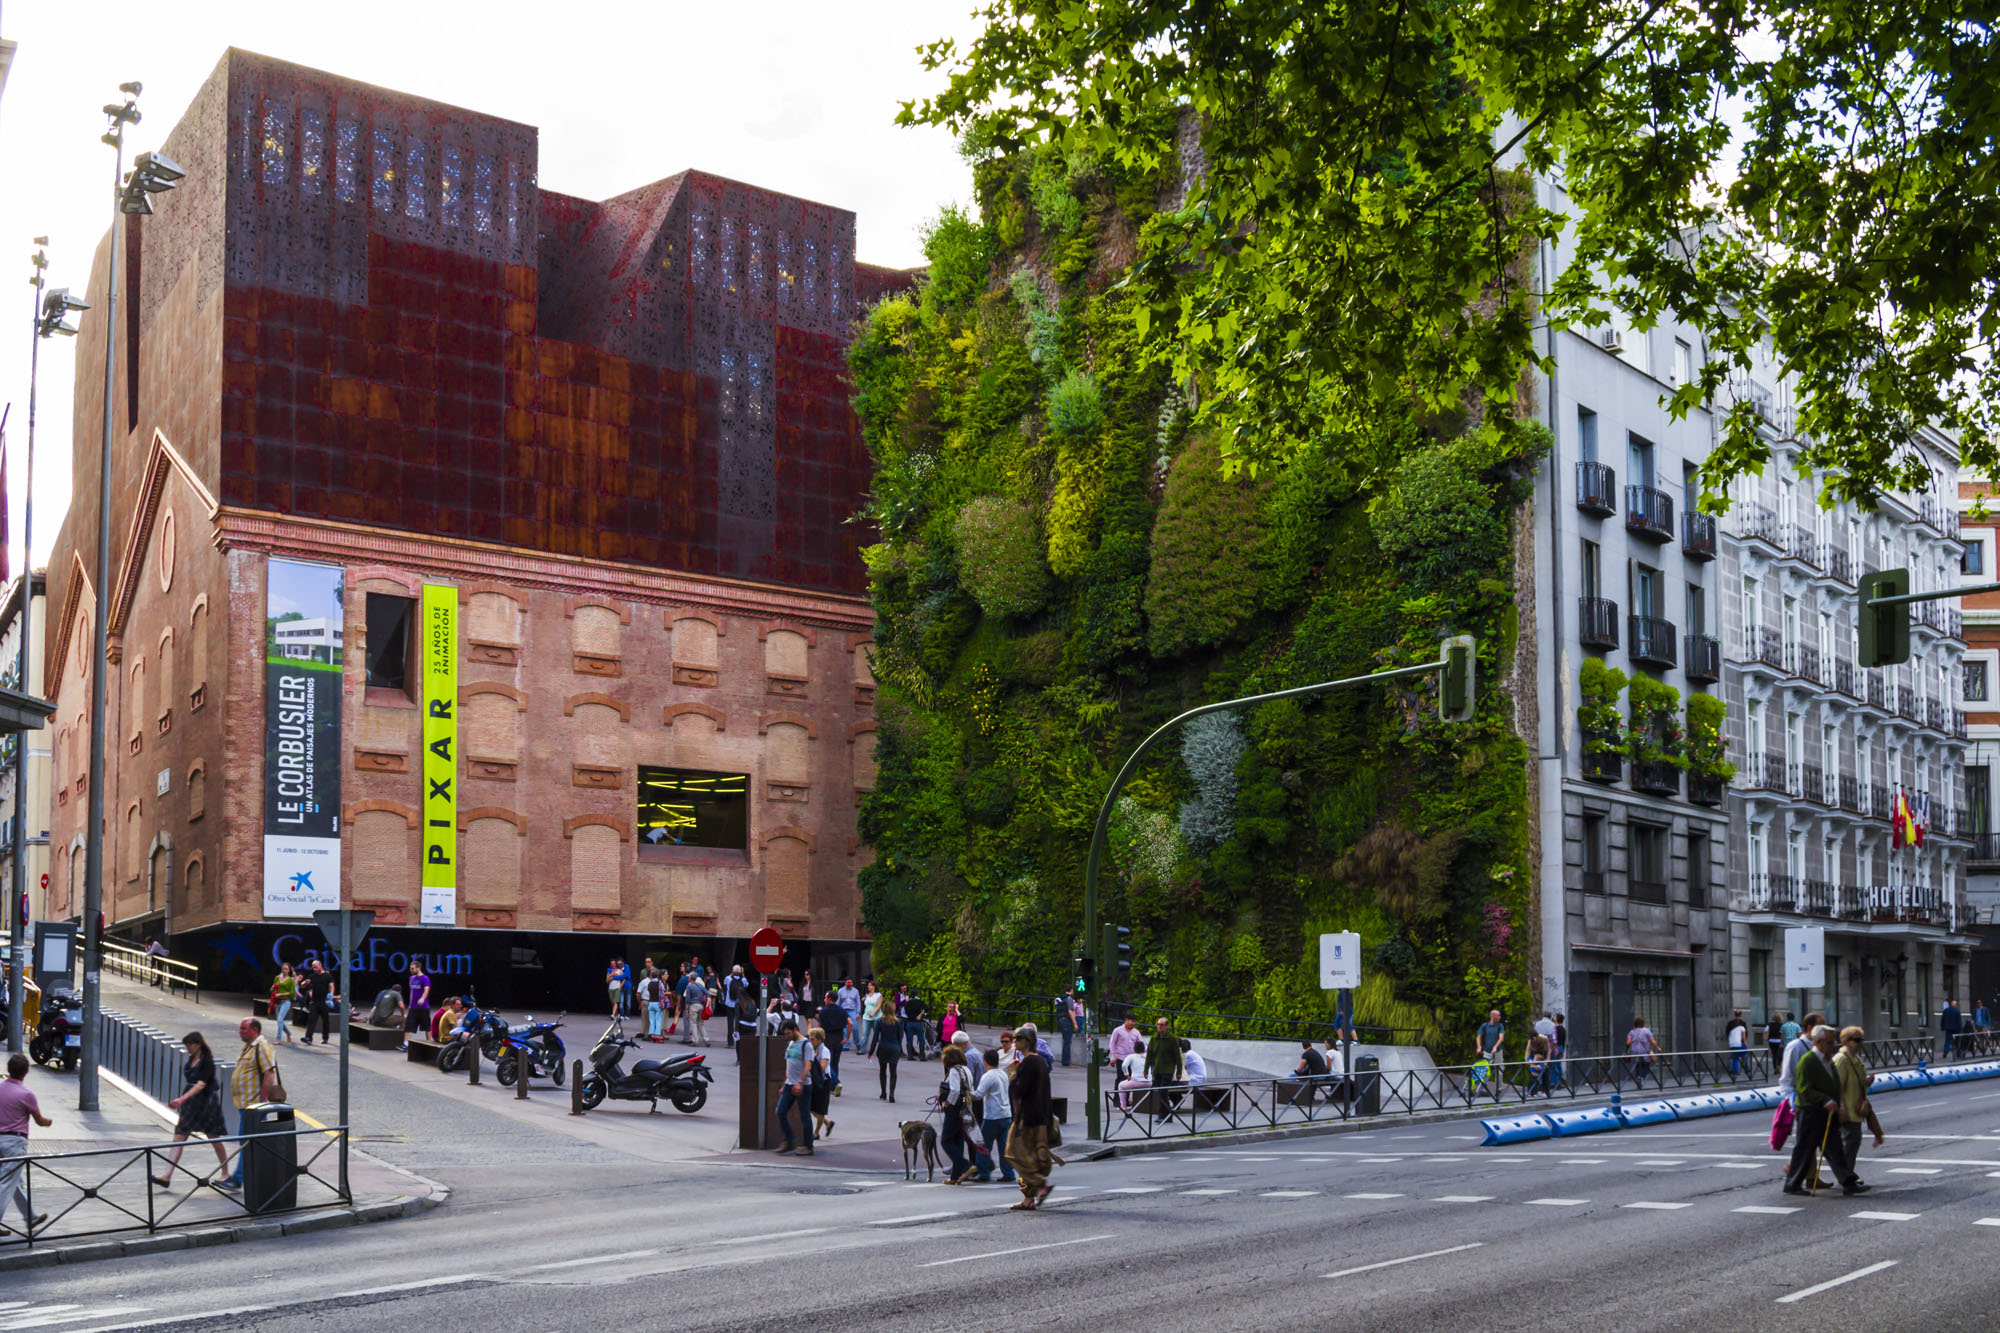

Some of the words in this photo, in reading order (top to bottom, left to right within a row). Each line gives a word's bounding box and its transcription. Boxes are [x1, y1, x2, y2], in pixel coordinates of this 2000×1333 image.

[434, 606, 441, 619] DE
[432, 624, 441, 656] AÑOS
[434, 661, 441, 674] 25
[306, 677, 315, 721] MODERNOS
[278, 675, 306, 797] CORBUSIER
[306, 723, 314, 760] PAISAJES
[306, 762, 314, 773] DE
[306, 775, 314, 799] ATLAS
[428, 699, 452, 865] PIXAR
[277, 801, 304, 824] LE
[306, 801, 313, 813] UN
[1869, 886, 1921, 907] HOTEL
